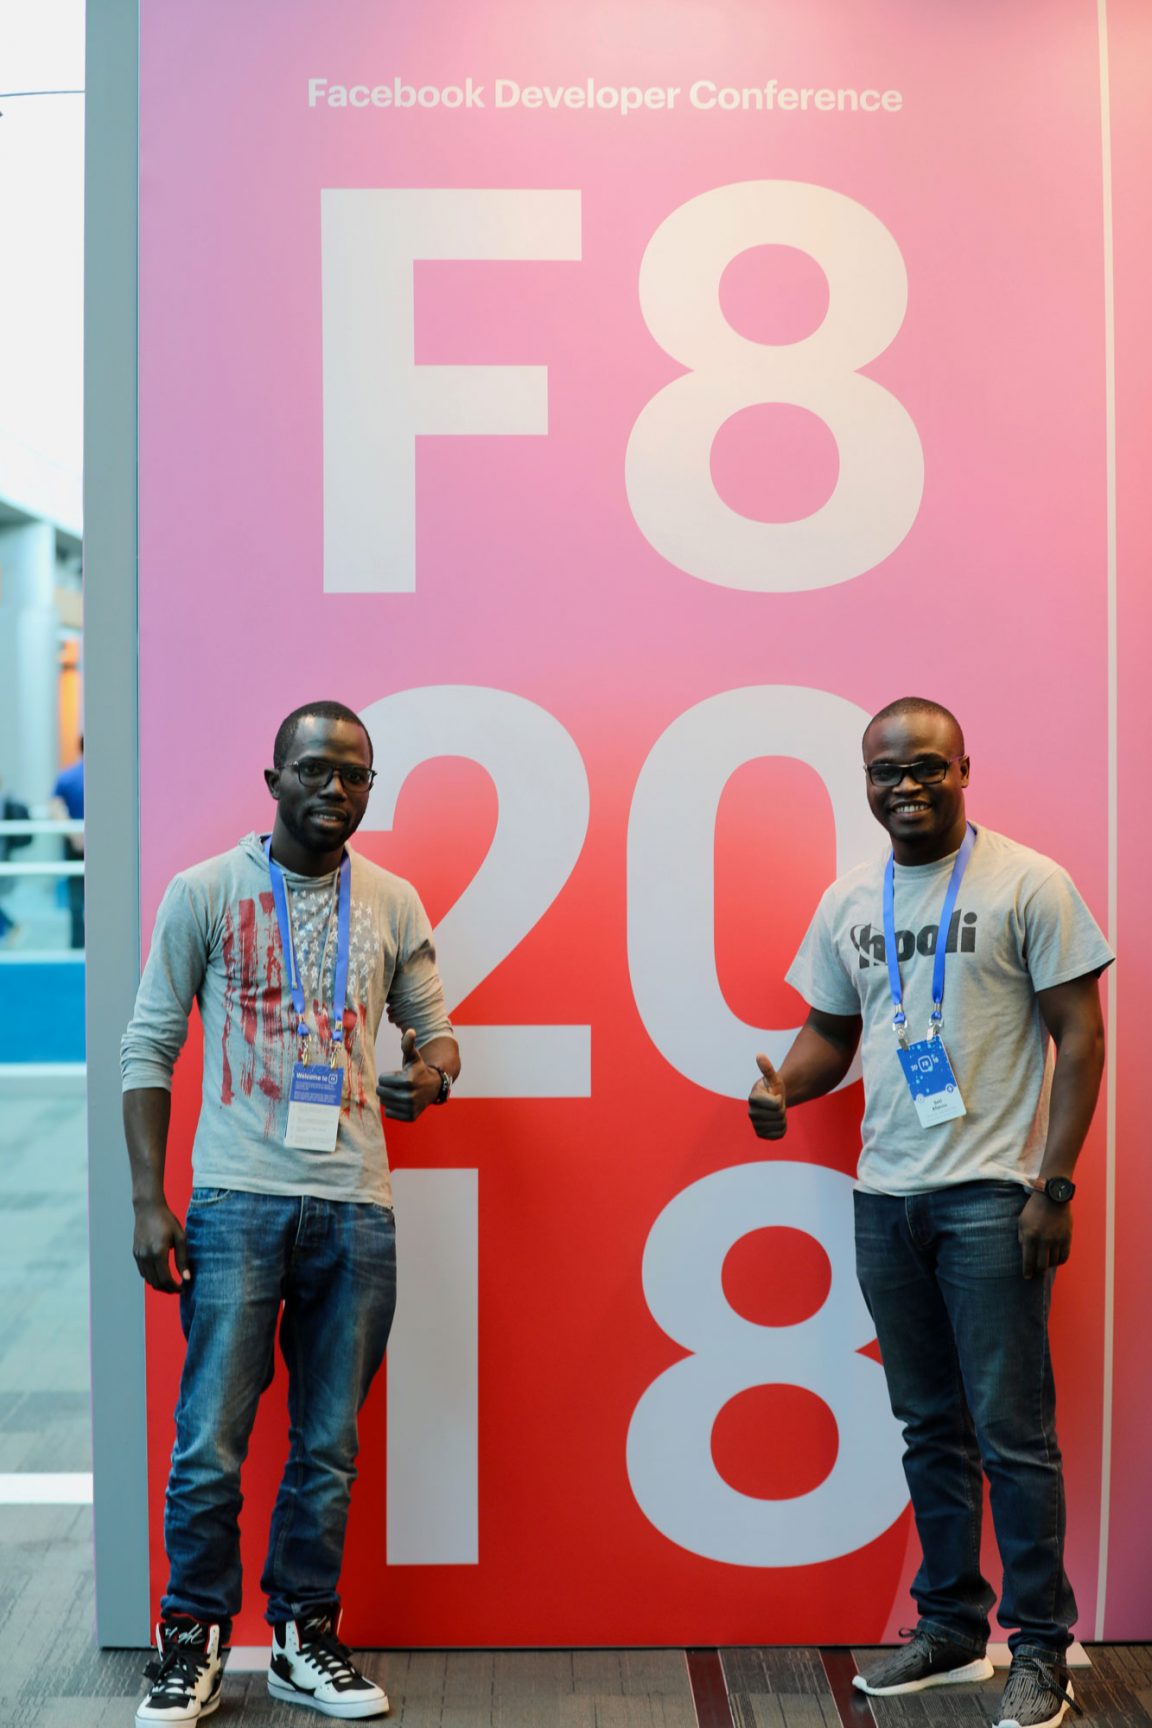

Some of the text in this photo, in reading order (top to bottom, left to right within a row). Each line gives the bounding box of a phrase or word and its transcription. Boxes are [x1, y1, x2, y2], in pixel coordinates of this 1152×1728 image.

[307, 77, 904, 116] Facebook Developer Conference
[320, 179, 925, 594] F8
[356, 684, 876, 1101] 20
[386, 1160, 912, 1568] 18
